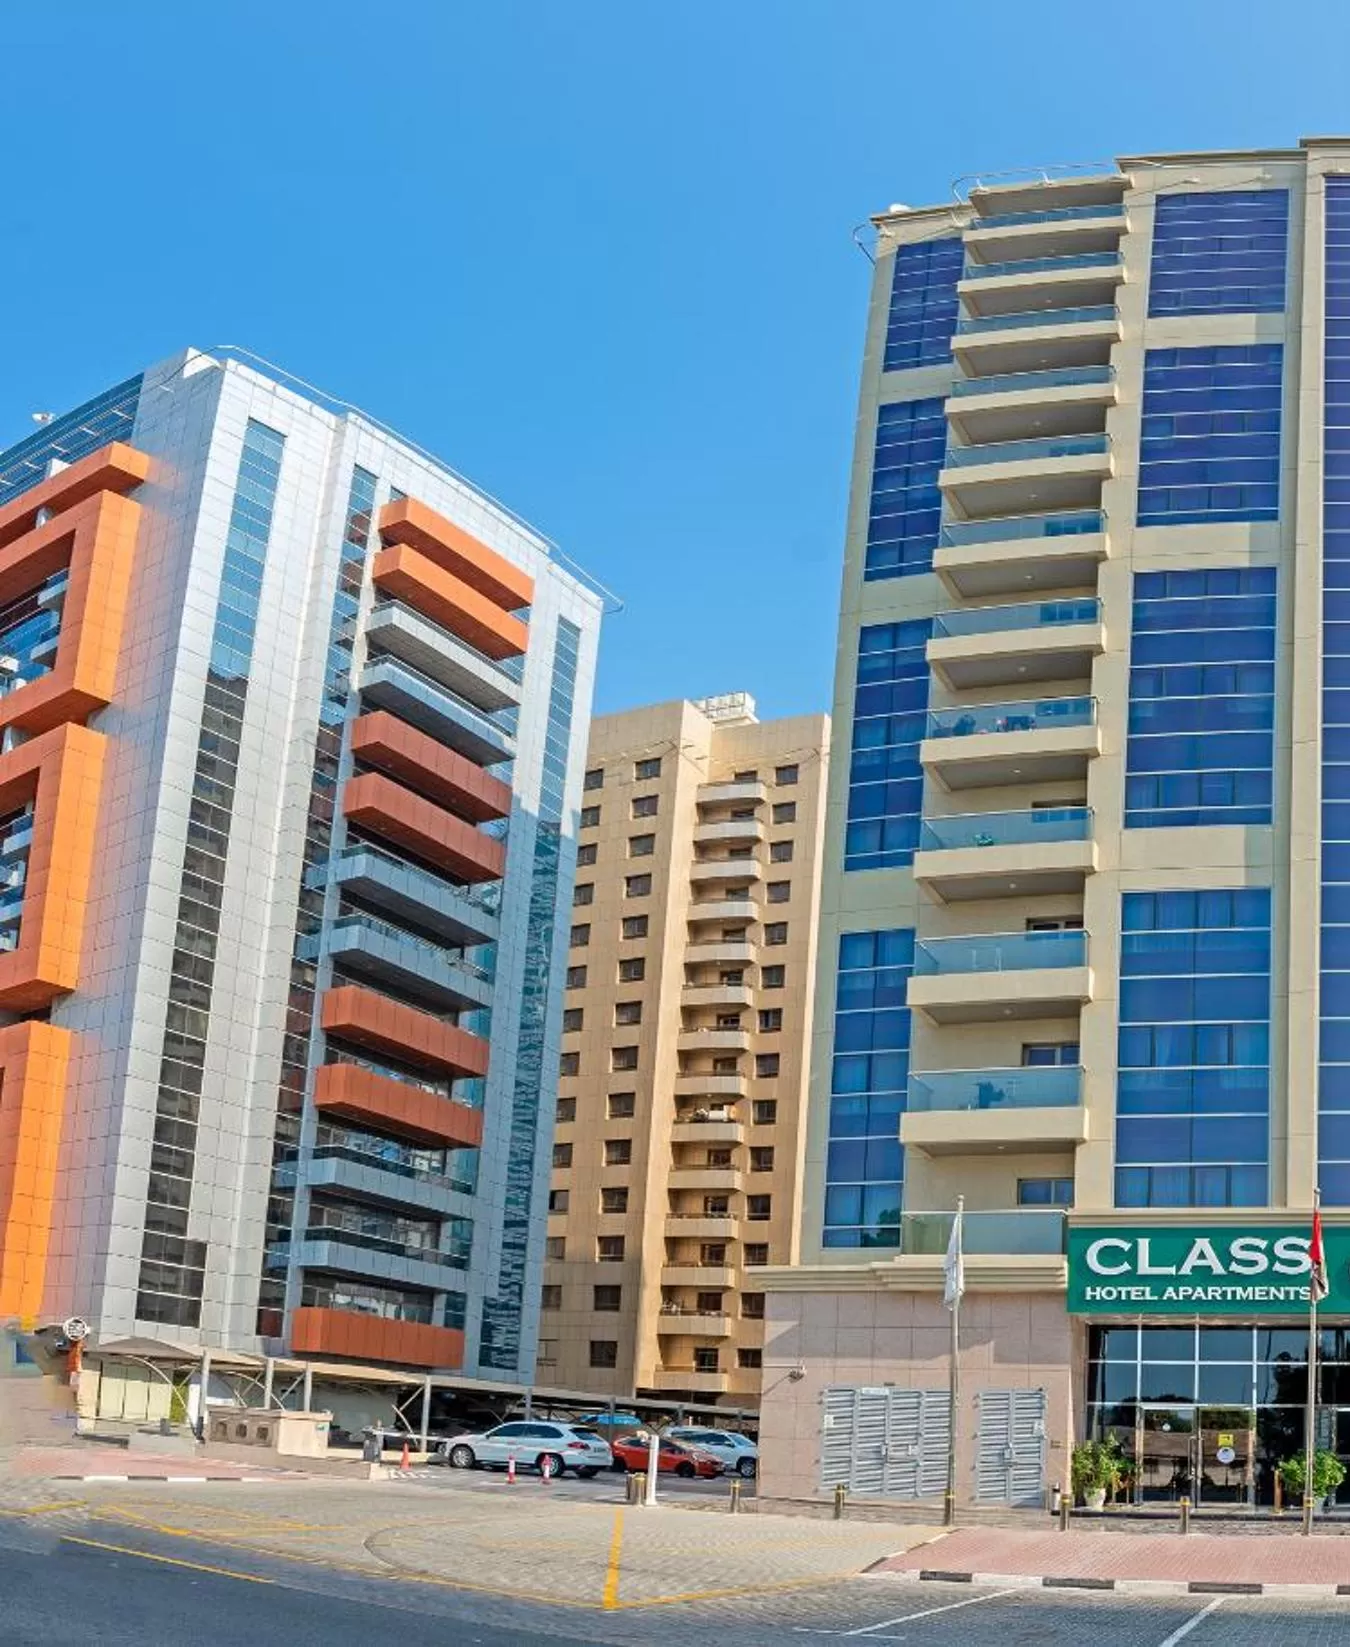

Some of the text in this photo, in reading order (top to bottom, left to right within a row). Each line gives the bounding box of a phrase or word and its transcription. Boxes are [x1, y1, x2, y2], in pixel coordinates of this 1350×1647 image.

[1085, 1237, 1312, 1276] CLASS
[1085, 1286, 1312, 1301] HOTEL APARTMENTS
